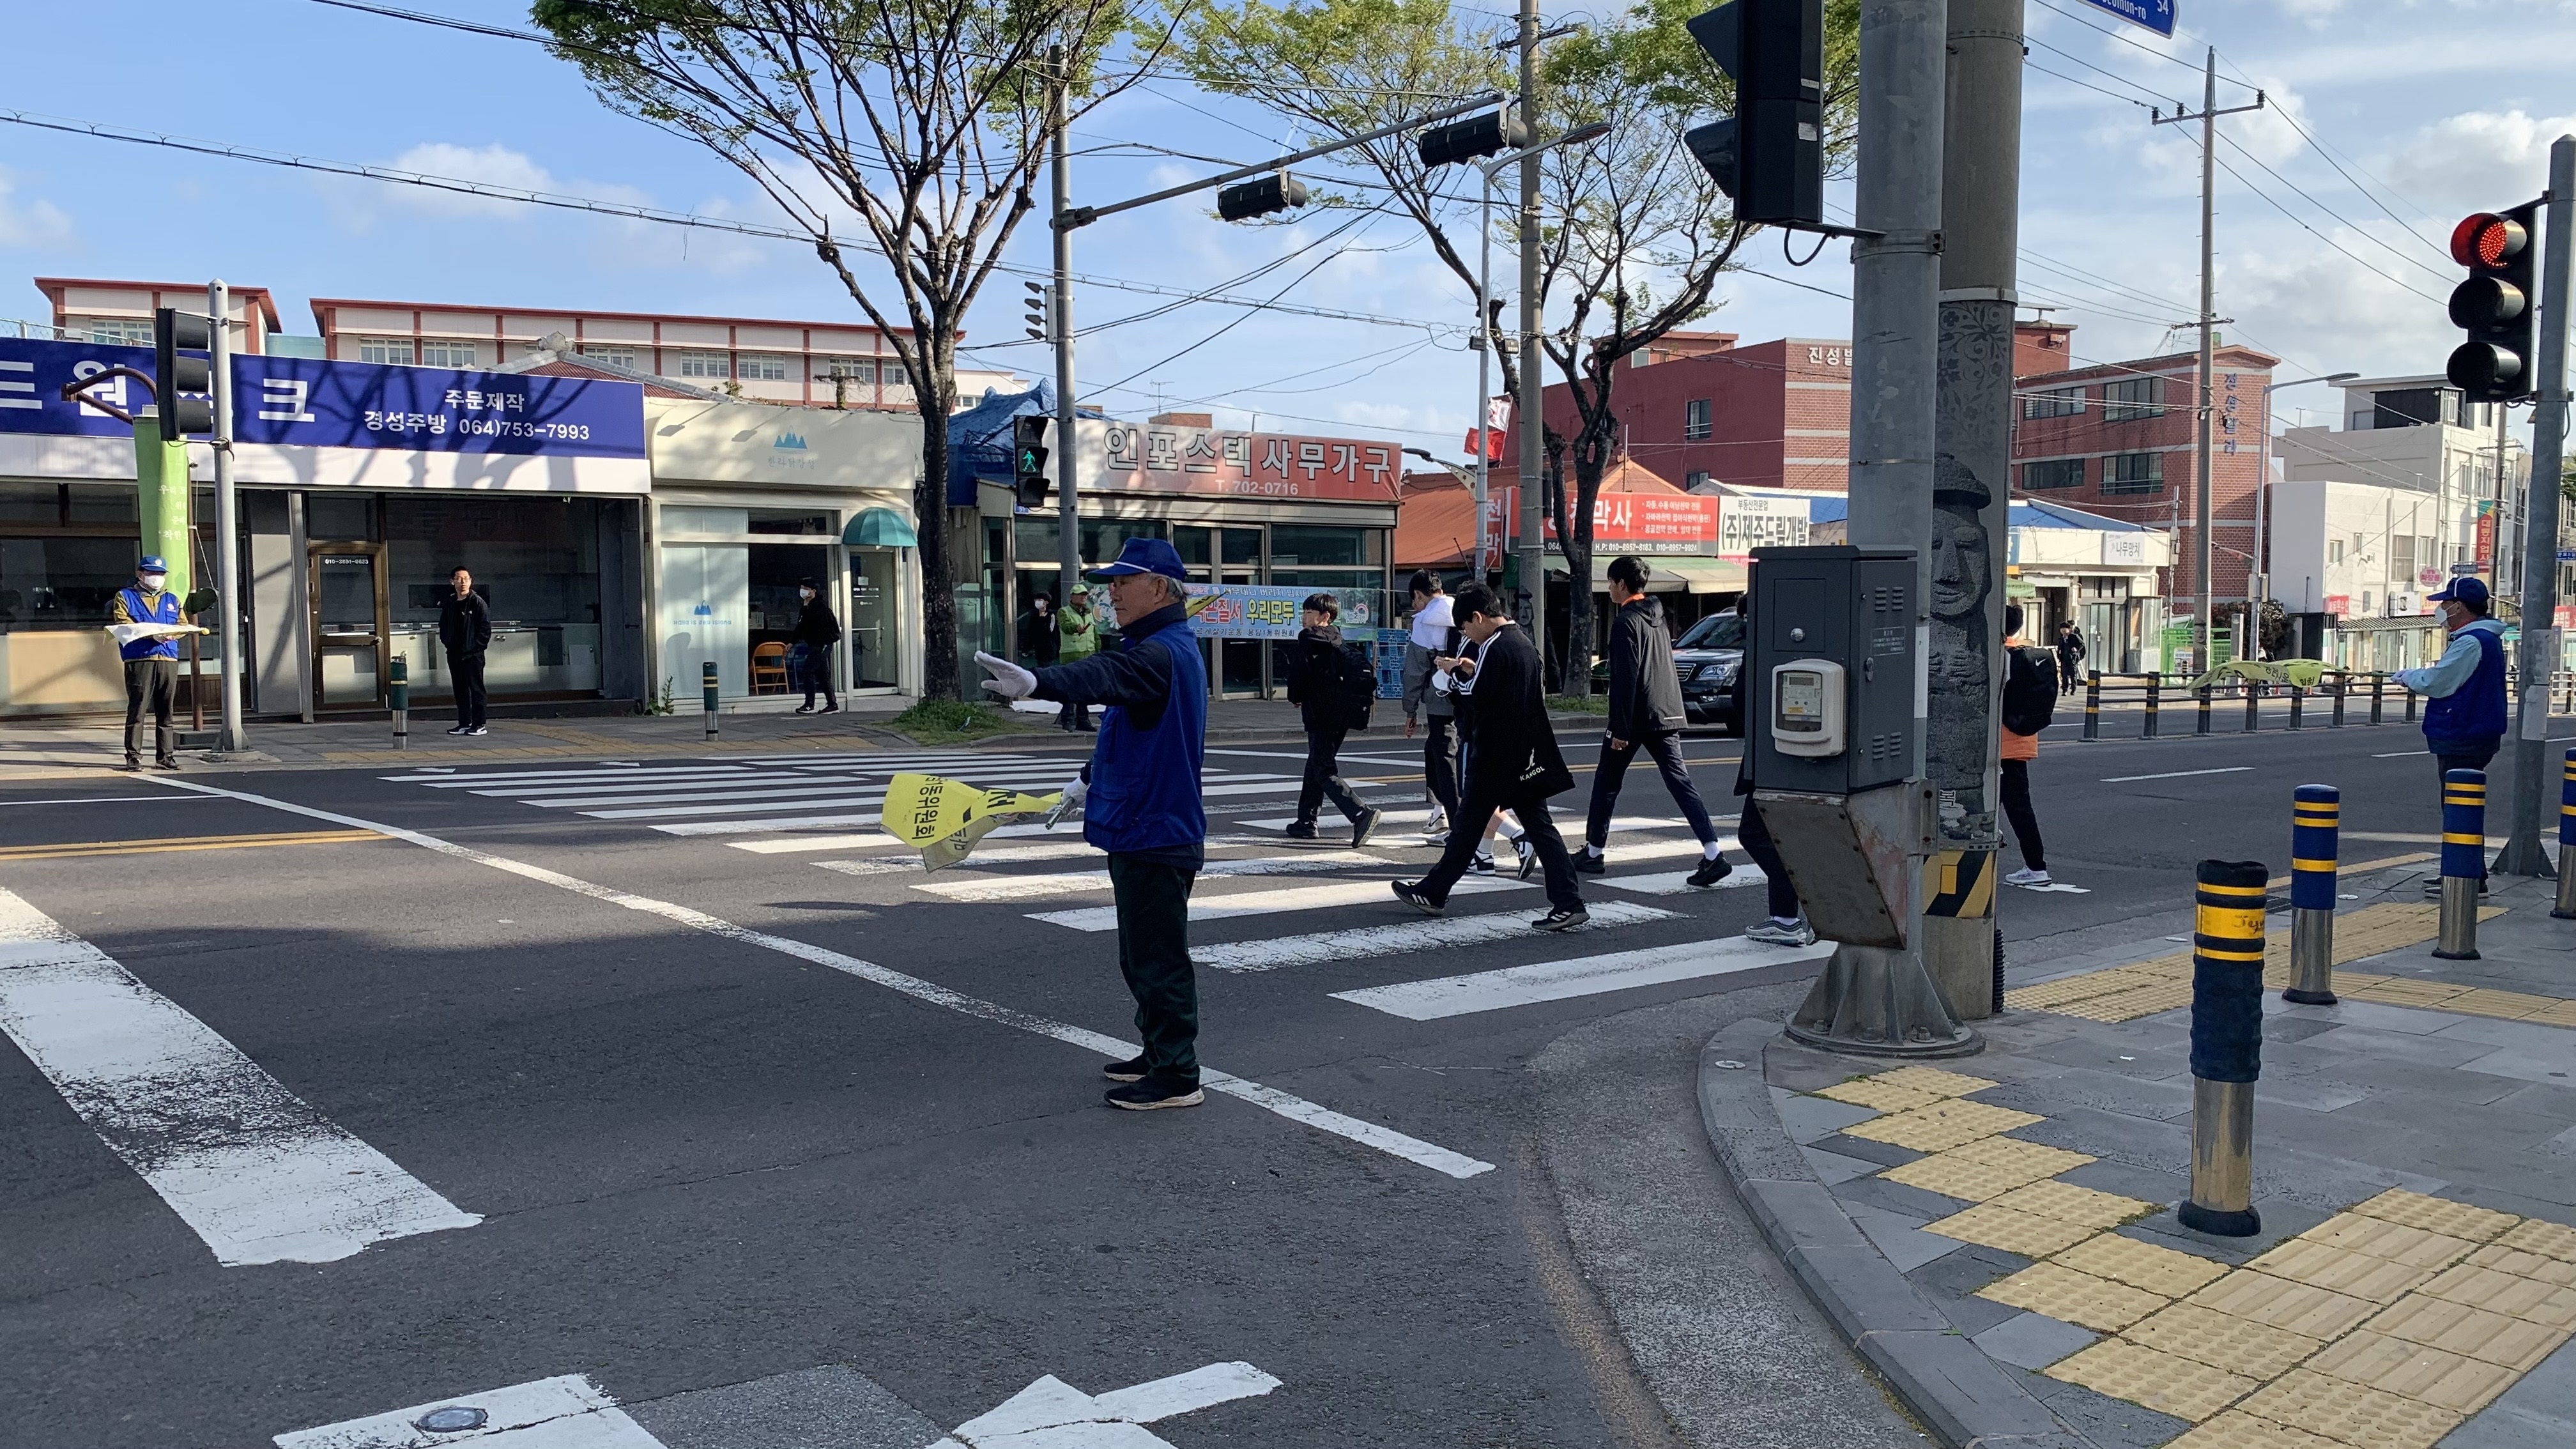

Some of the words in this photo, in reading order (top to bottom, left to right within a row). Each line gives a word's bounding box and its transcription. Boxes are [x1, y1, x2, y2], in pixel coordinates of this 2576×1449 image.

[2102, 0, 2146, 20] omun-ro
[445, 389, 525, 412] 주문제작
[364, 411, 447, 434] 경성주방
[459, 418, 590, 440] 064)753-7993
[1103, 427, 1252, 478] 인포스텍
[1261, 440, 1391, 484] 사무가구
[1234, 481, 1299, 496] 702-0716
[1738, 499, 1768, 511] 부동산전문업
[1722, 512, 1808, 550] (주)제주드림개발
[2116, 542, 2140, 557] 나무망치
[1246, 599, 1295, 625] 우리모두
[1520, 766, 1545, 781] KANGOL
